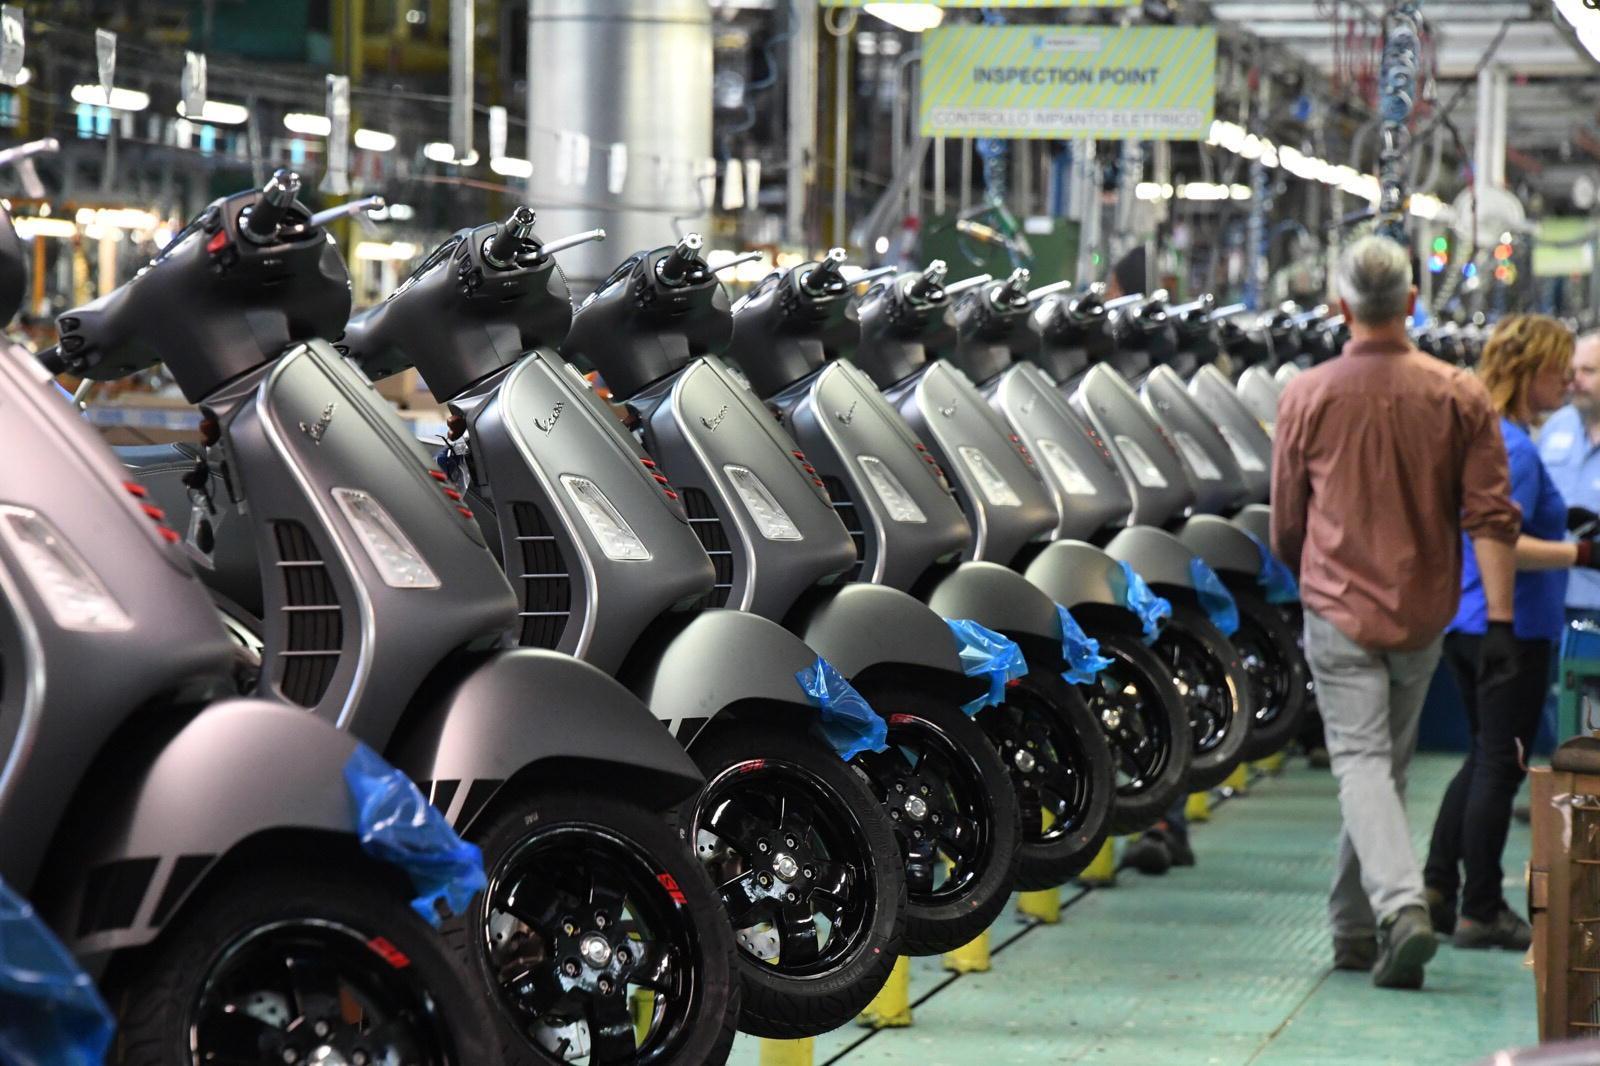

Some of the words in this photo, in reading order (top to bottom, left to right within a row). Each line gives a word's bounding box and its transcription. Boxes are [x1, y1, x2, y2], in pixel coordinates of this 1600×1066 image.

[973, 67, 1092, 85] INSPECTION
[1099, 67, 1159, 85] POINT
[935, 111, 1028, 125] CONTROLLO
[1034, 112, 1106, 126] IMPIANTO
[1112, 112, 1198, 126] ELETTRICO
